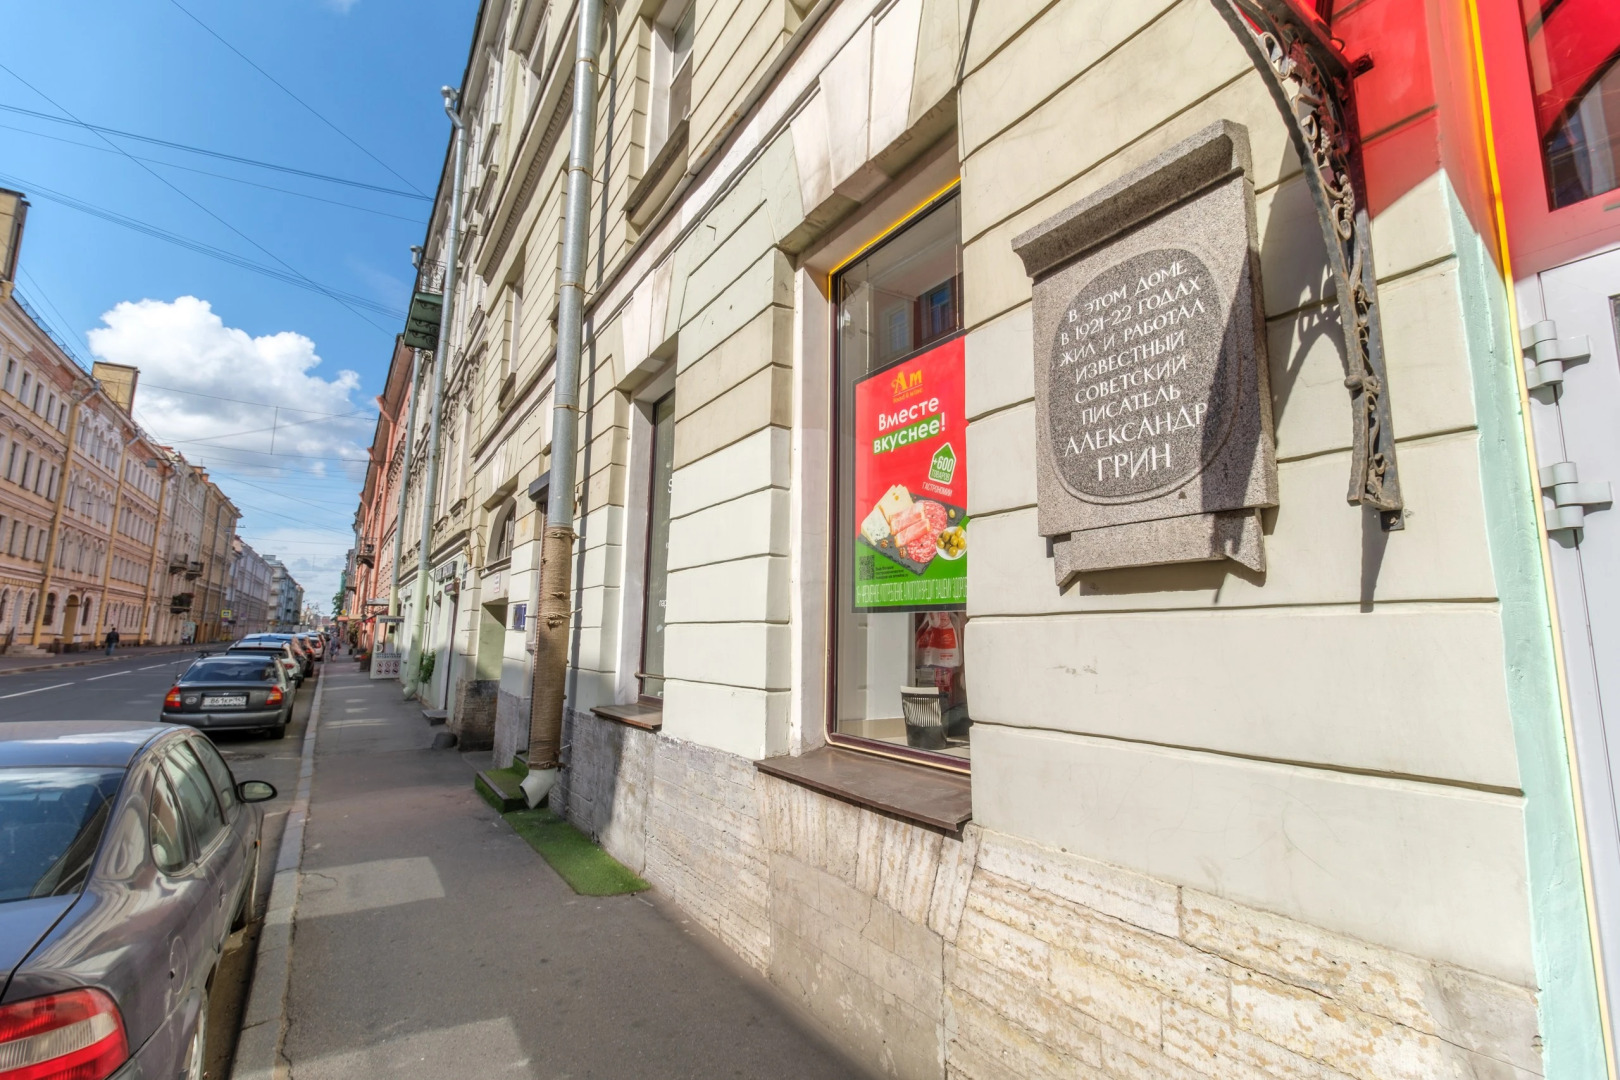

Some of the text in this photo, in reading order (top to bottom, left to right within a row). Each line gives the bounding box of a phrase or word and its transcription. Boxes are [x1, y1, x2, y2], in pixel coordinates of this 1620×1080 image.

[1060, 276, 1202, 346] В 1921-22 ГОДАХ
[1068, 260, 1188, 323] В ЭТОМ ДОМЕ
[1058, 298, 1206, 367] ЖИЛ И РАБОТАЛ
[1075, 328, 1186, 385] ИЗВЕСТНЫЙ
[1074, 353, 1188, 404] СОВЕТСКИЙ
[878, 397, 939, 432] Вместе
[1064, 402, 1209, 458] АЛЕКСАНДР
[1081, 383, 1181, 426] ПИСАТЕЛЬ
[873, 412, 946, 452] вкуснее!
[933, 456, 954, 473] +600
[1096, 443, 1172, 482] ГРИН
